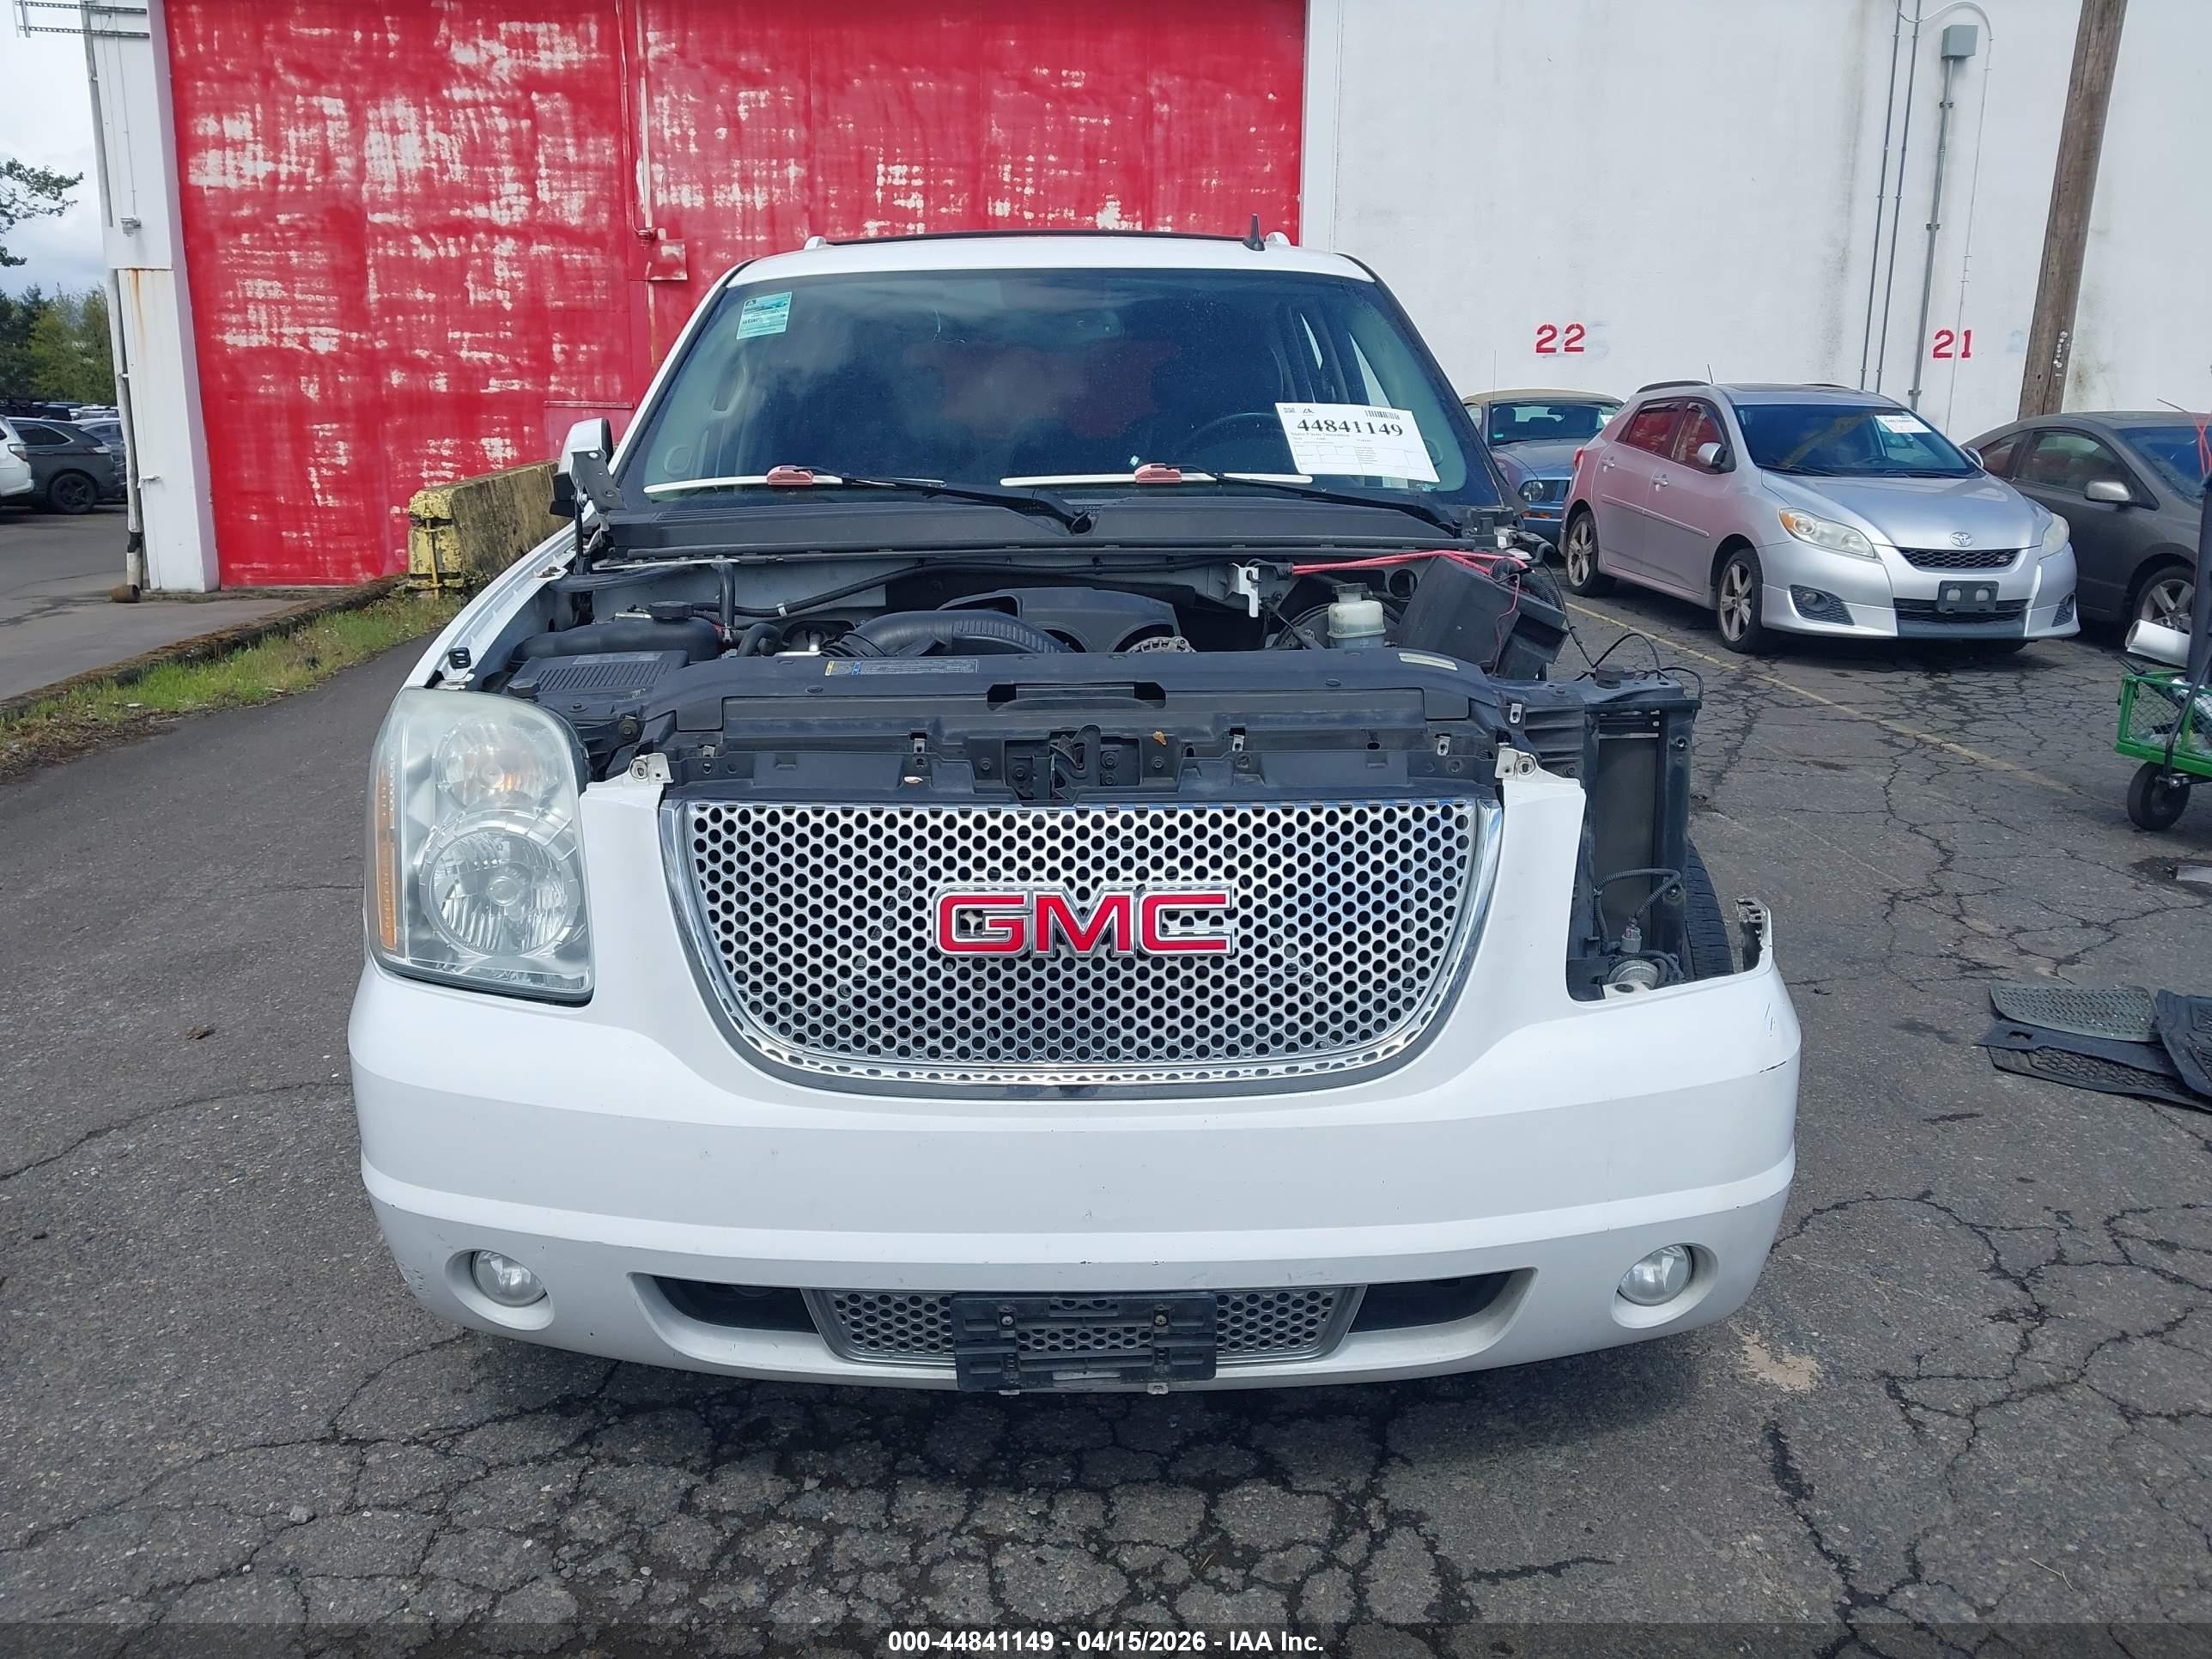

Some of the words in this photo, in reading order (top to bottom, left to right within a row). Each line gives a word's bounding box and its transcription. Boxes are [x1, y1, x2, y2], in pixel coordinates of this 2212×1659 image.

[1535, 323, 1585, 354] 22
[1932, 329, 1972, 359] 21
[1297, 418, 1403, 437] 44841149
[933, 884, 1233, 957] GMC
